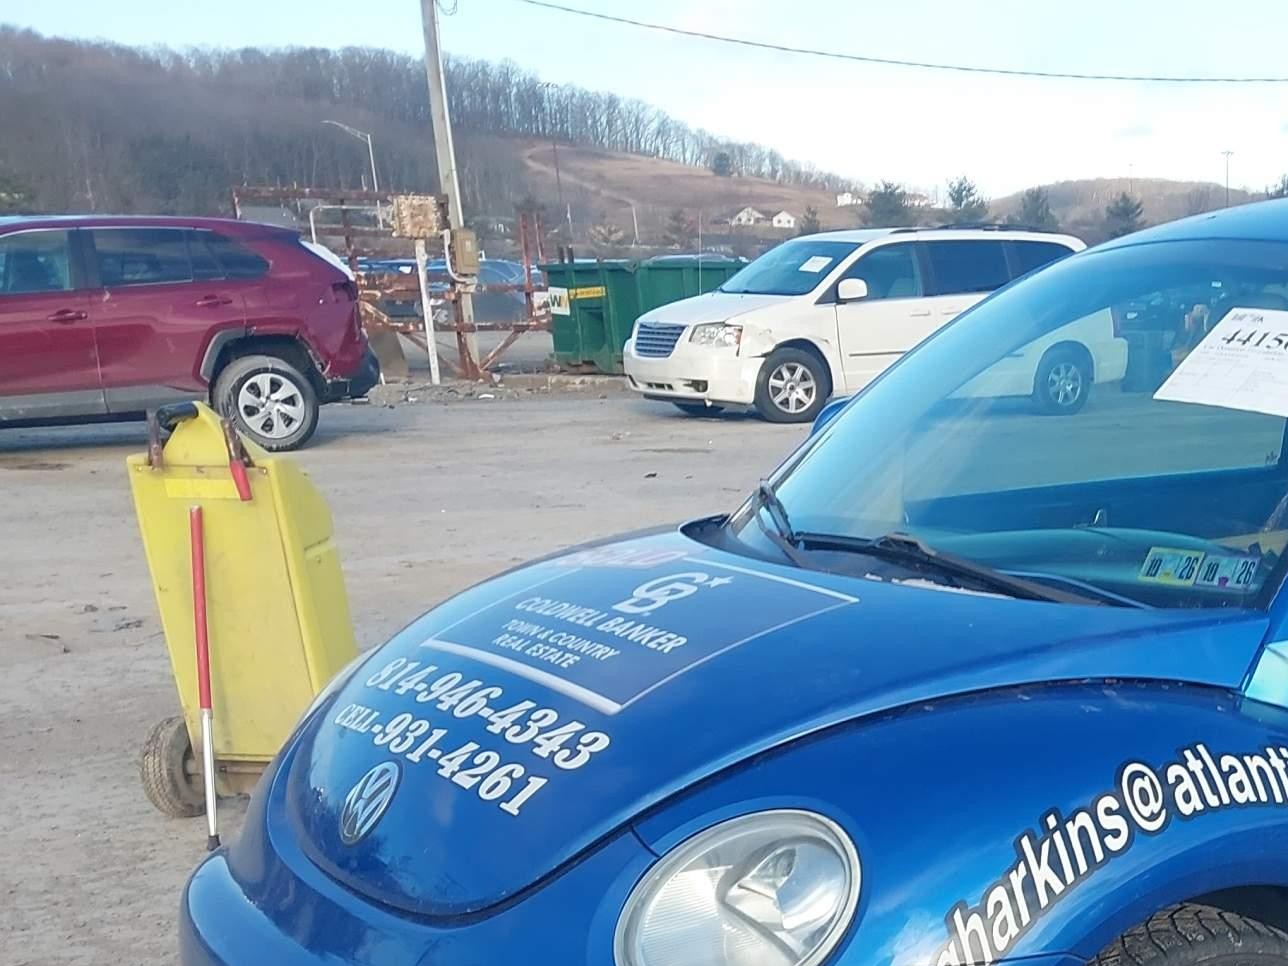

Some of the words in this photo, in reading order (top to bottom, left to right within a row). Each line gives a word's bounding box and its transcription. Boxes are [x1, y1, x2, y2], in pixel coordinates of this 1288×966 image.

[1146, 558, 1162, 578] 10
[1178, 556, 1199, 581] 26
[502, 619, 543, 638] TOWN
[548, 632, 621, 661] COUNTRY
[515, 597, 608, 627] COLDWELL
[596, 616, 688, 654] BANKER
[492, 633, 532, 652] REAL
[525, 642, 582, 669] ESTATE
[366, 657, 611, 770] 814-946-4343
